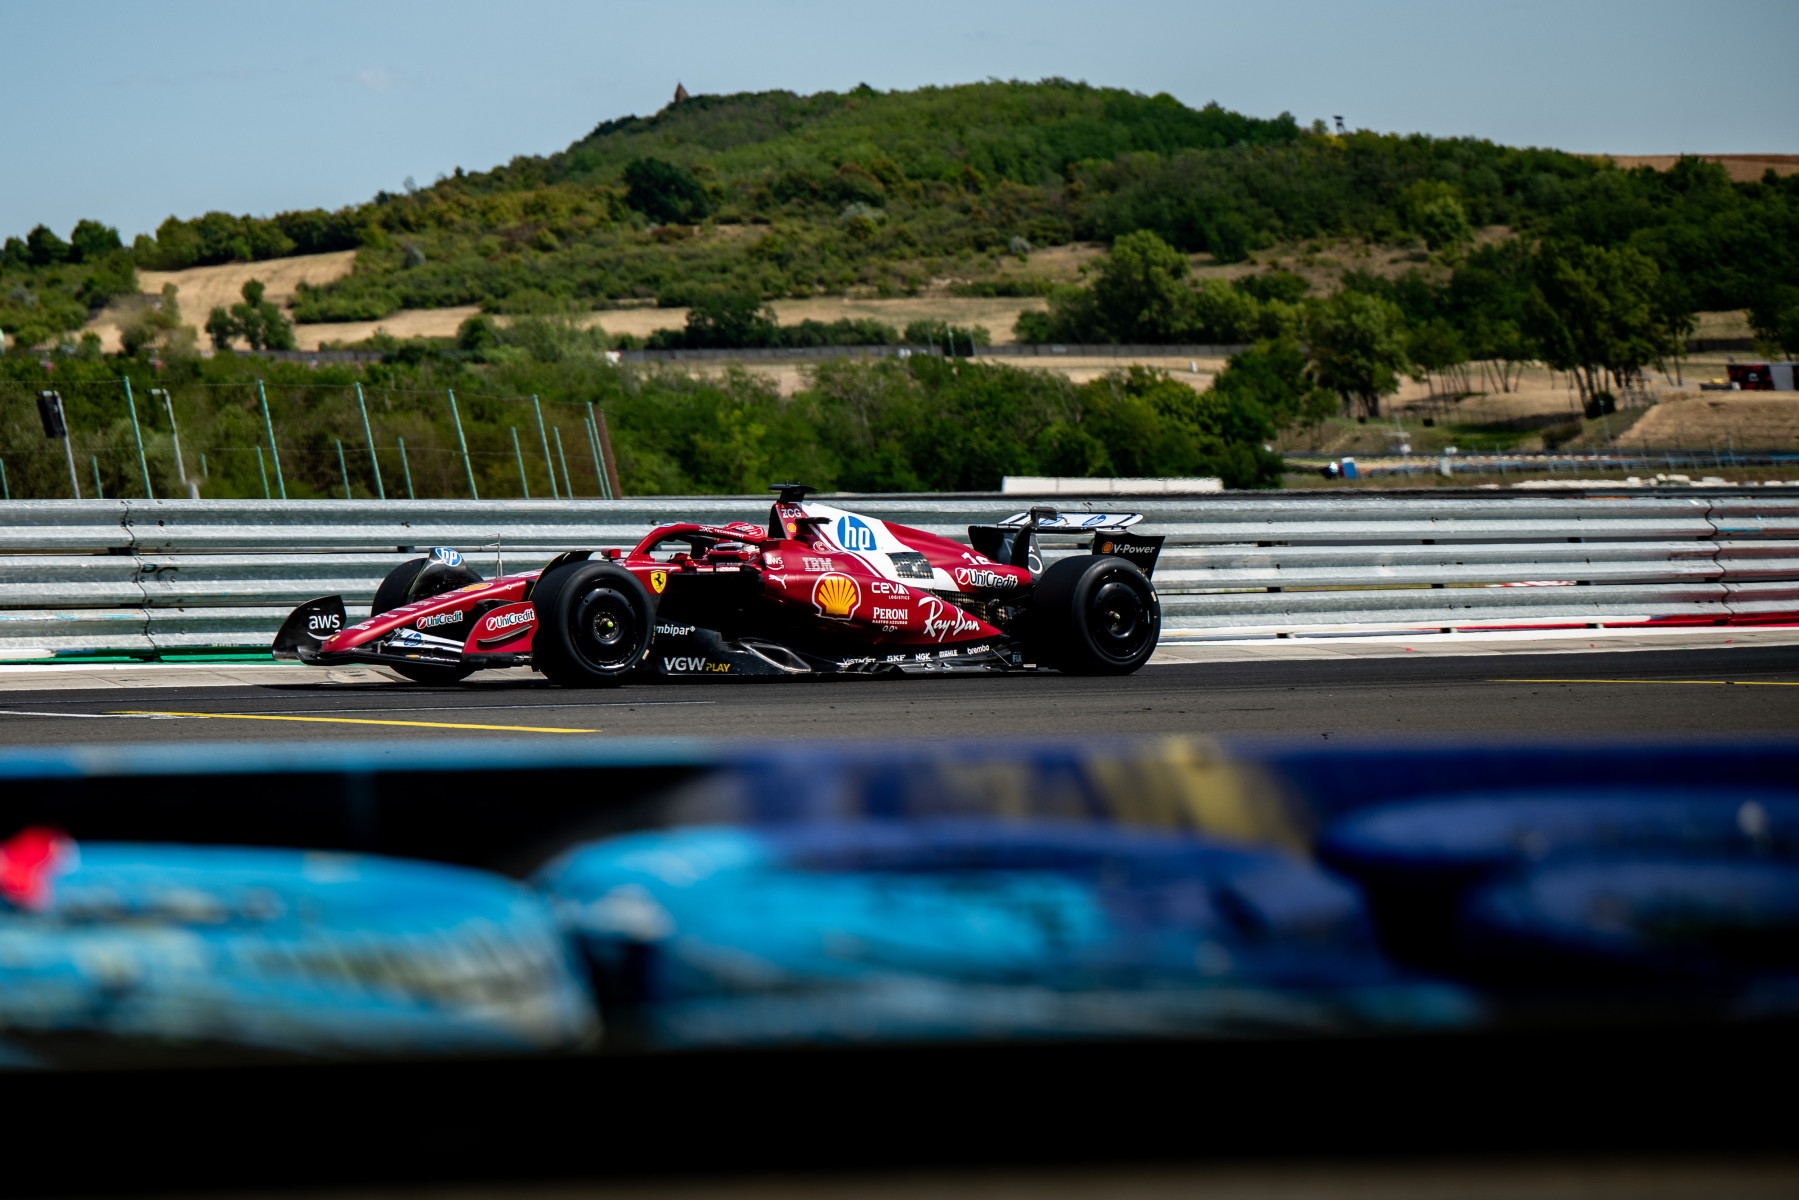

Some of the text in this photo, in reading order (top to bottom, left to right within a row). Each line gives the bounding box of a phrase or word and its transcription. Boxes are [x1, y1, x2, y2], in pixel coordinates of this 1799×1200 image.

[781, 508, 802, 519] ZCG
[841, 515, 874, 552] hp
[1113, 543, 1156, 554] V-Power
[438, 548, 461, 566] hp
[802, 557, 835, 571] IBM
[969, 568, 1018, 589] UniCredit
[426, 609, 463, 628] UniCredit
[496, 608, 535, 630] UniCredit
[873, 606, 909, 620] PERONI
[308, 613, 341, 630] aws
[656, 623, 690, 637] mbipar
[915, 652, 932, 662] NGK
[939, 649, 959, 659] MAHLE
[967, 644, 990, 656] brembo
[663, 657, 731, 672] VGW PLAY
[886, 654, 907, 663] SKF
